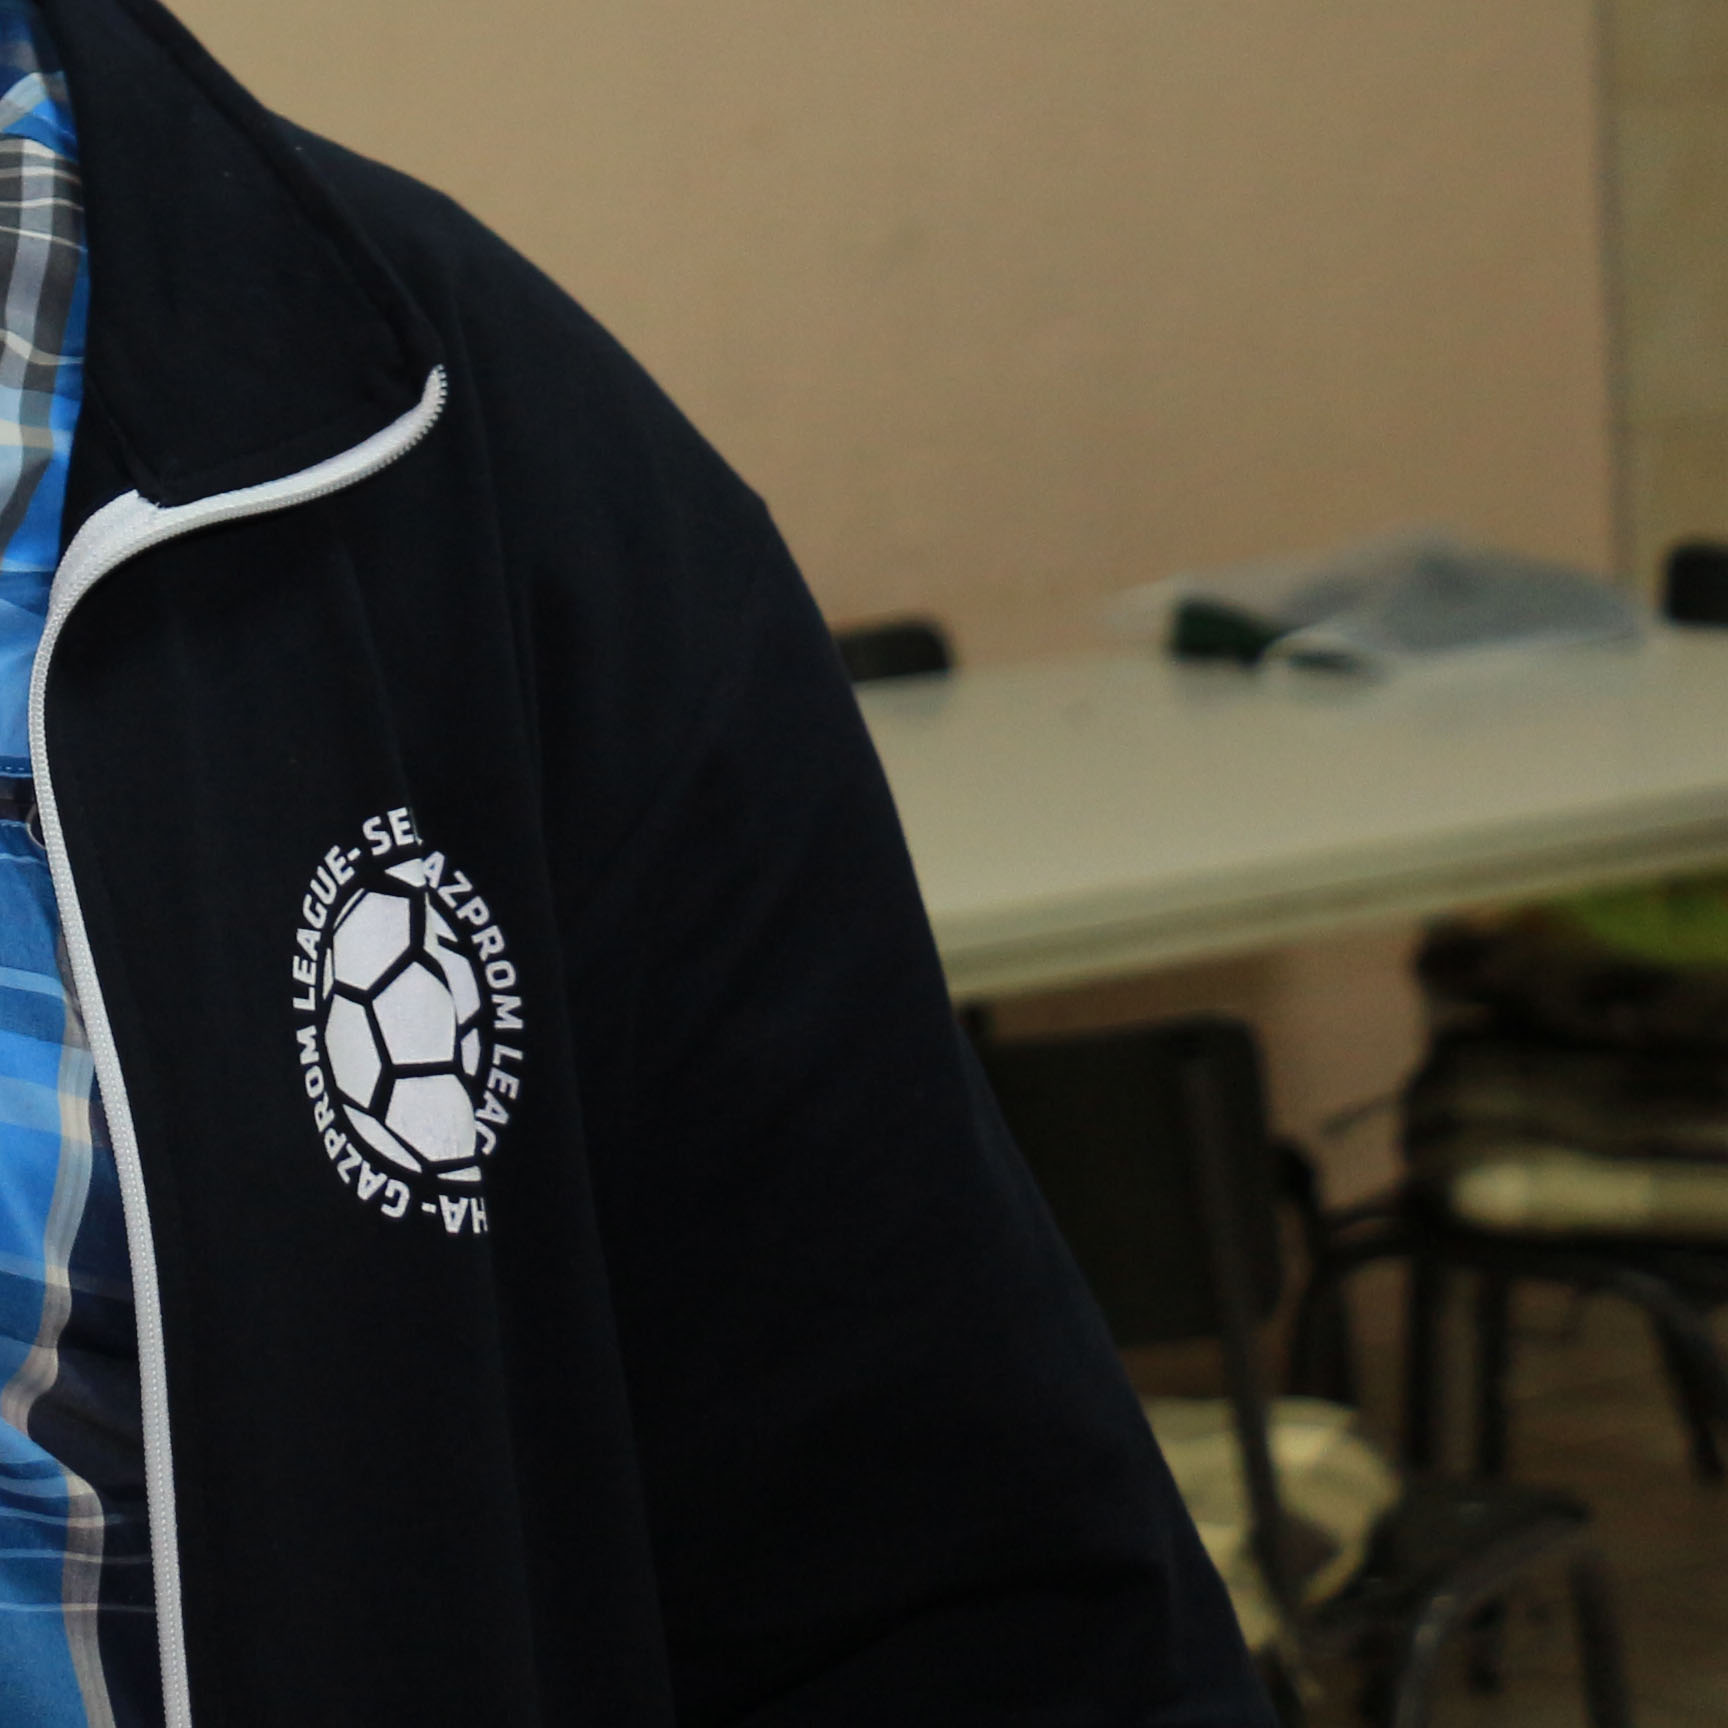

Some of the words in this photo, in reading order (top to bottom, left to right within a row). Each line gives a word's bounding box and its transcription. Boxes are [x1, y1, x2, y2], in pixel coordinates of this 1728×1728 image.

[296, 1024, 411, 1218] GAZPROM
[362, 806, 423, 856] SE
[421, 850, 524, 1030] AZPROM
